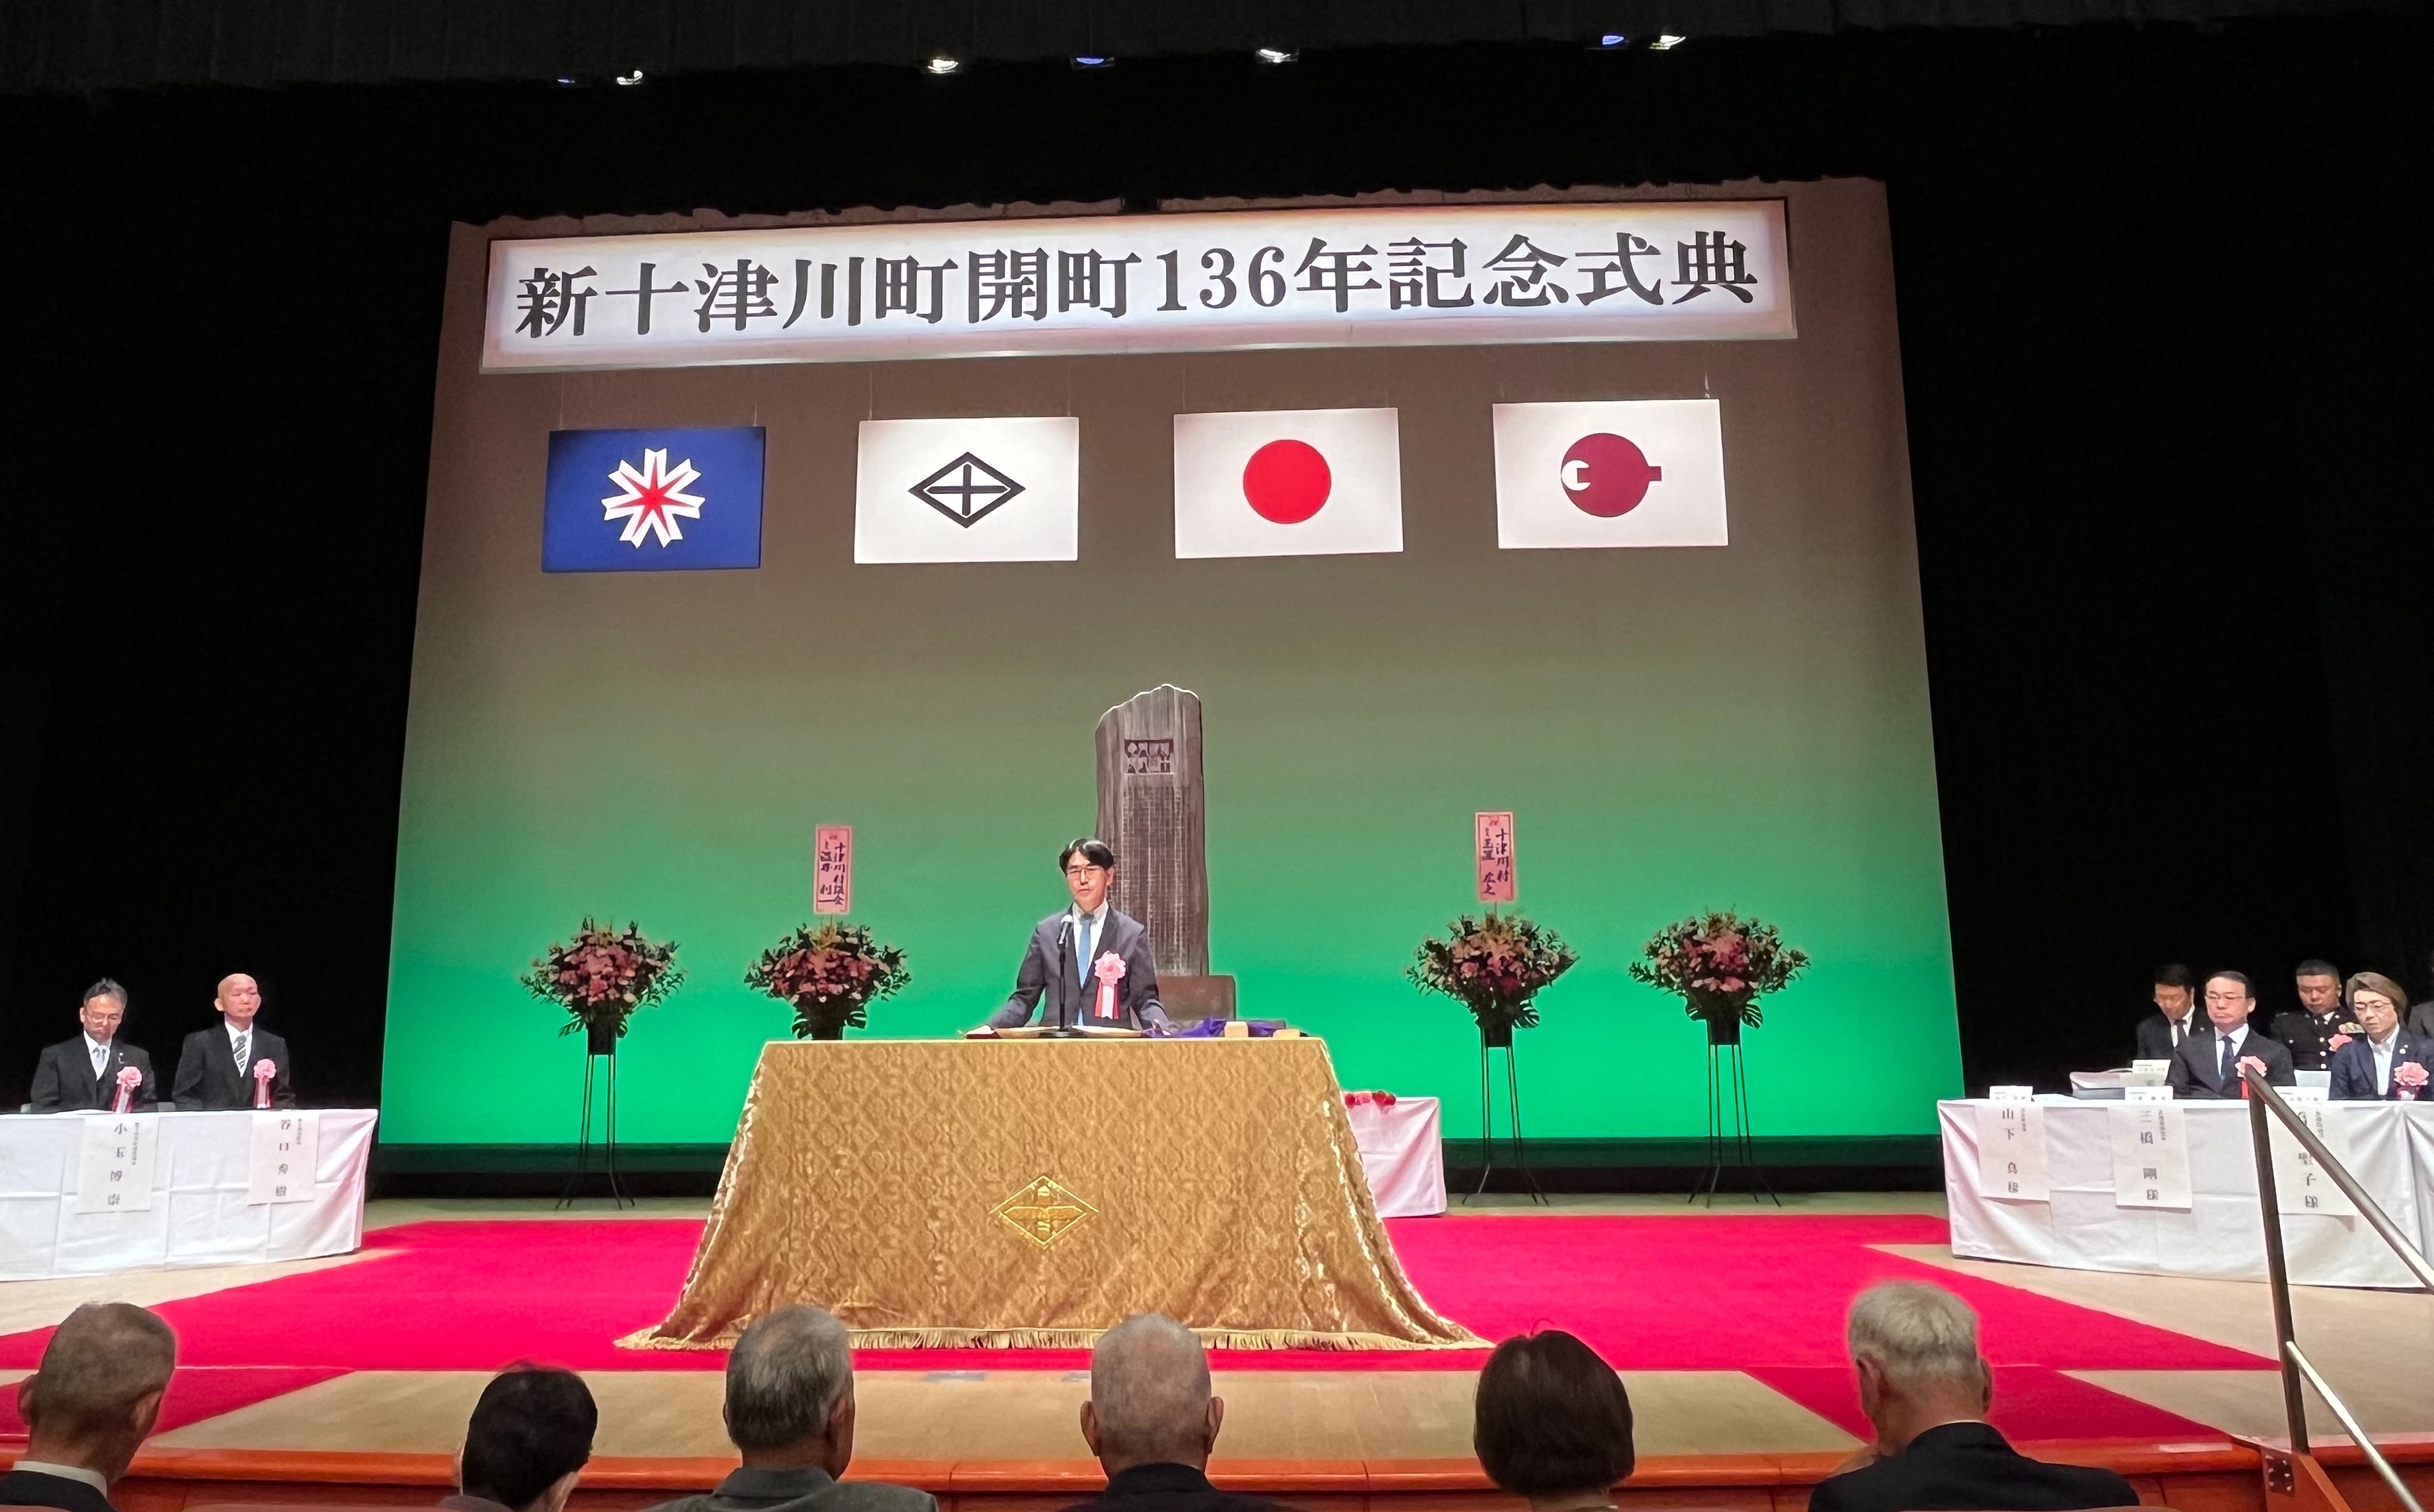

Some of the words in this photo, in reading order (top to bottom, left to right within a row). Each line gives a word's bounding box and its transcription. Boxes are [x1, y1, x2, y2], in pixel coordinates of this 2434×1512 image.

[515, 230, 1759, 338] 新十津川町開町136年記念式典
